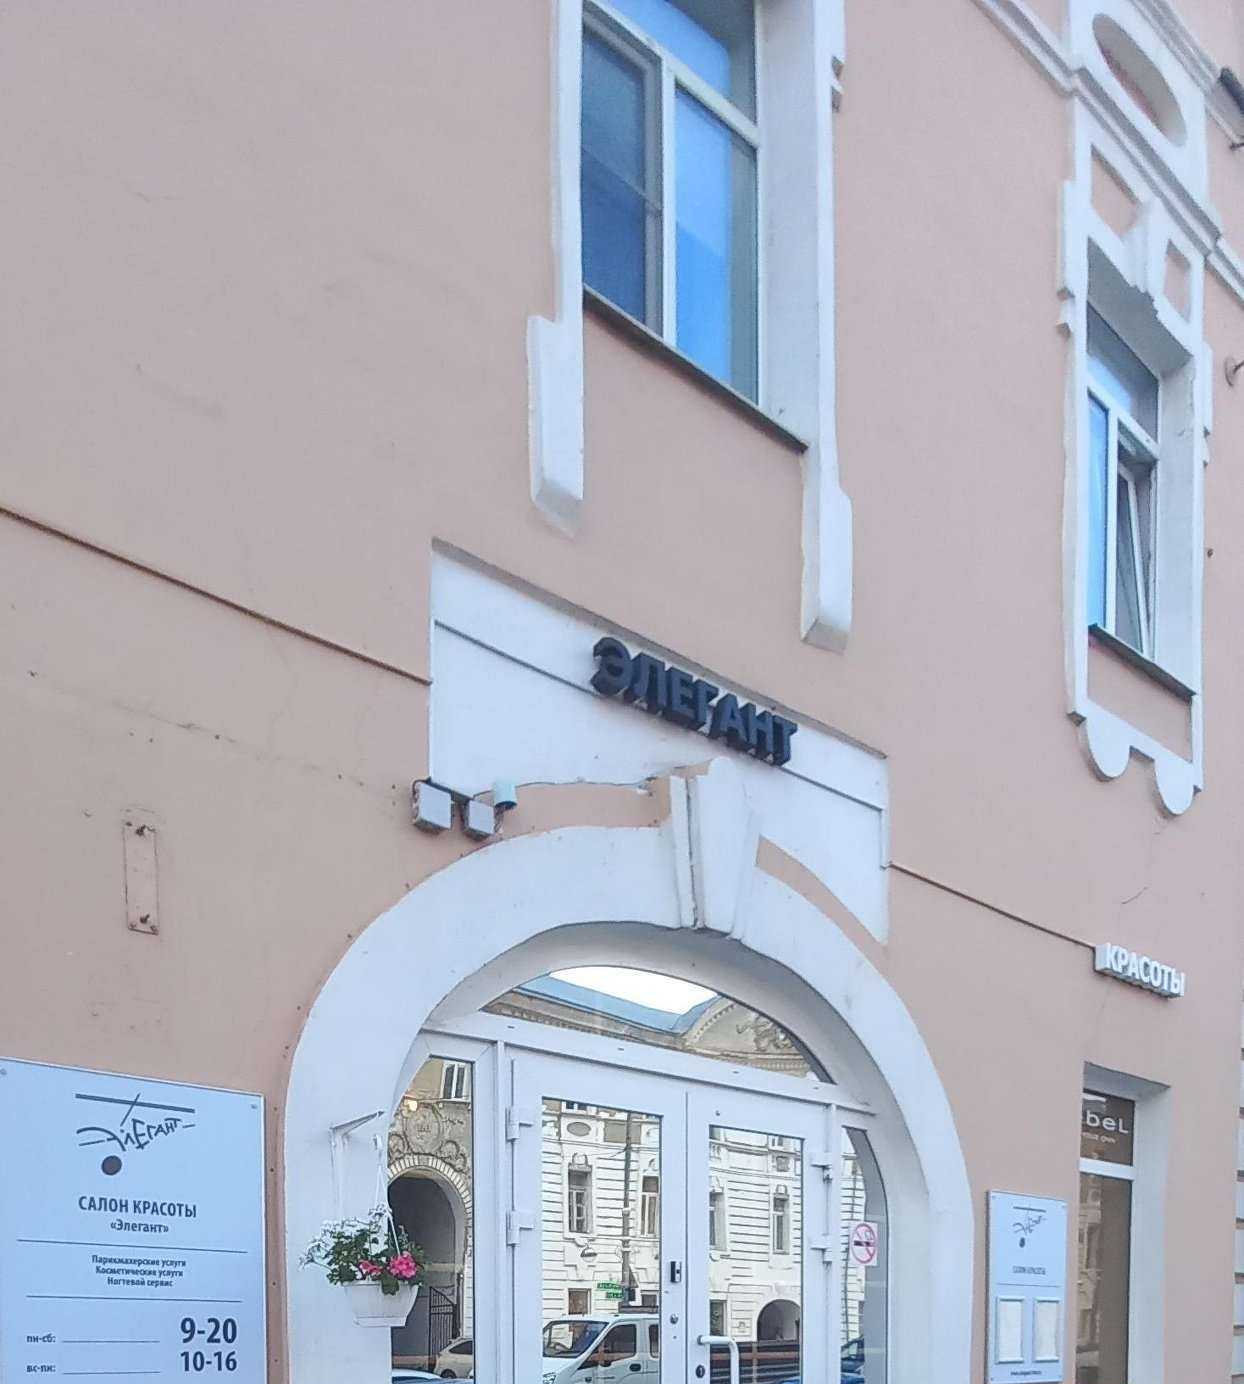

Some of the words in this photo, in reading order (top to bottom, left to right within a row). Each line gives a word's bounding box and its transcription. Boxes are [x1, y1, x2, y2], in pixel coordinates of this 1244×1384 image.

[591, 636, 798, 766] ЭЛЕГАНТ
[1104, 942, 1185, 996] КРАСОТЫ
[78, 1195, 129, 1213] САЛОН
[133, 1200, 197, 1218] КРАСОТЫ
[110, 1219, 169, 1234] «Элегант»
[92, 1255, 160, 1267] Парикмахерские
[161, 1259, 186, 1268] услуги
[96, 1266, 157, 1276] Косметические
[158, 1269, 184, 1278] услуги
[107, 1277, 146, 1286] Ногтевой
[147, 1280, 174, 1288] сервис
[26, 1333, 56, 1344] пн-сб:
[180, 1317, 238, 1344] 9-20
[180, 1351, 238, 1372] 10-16
